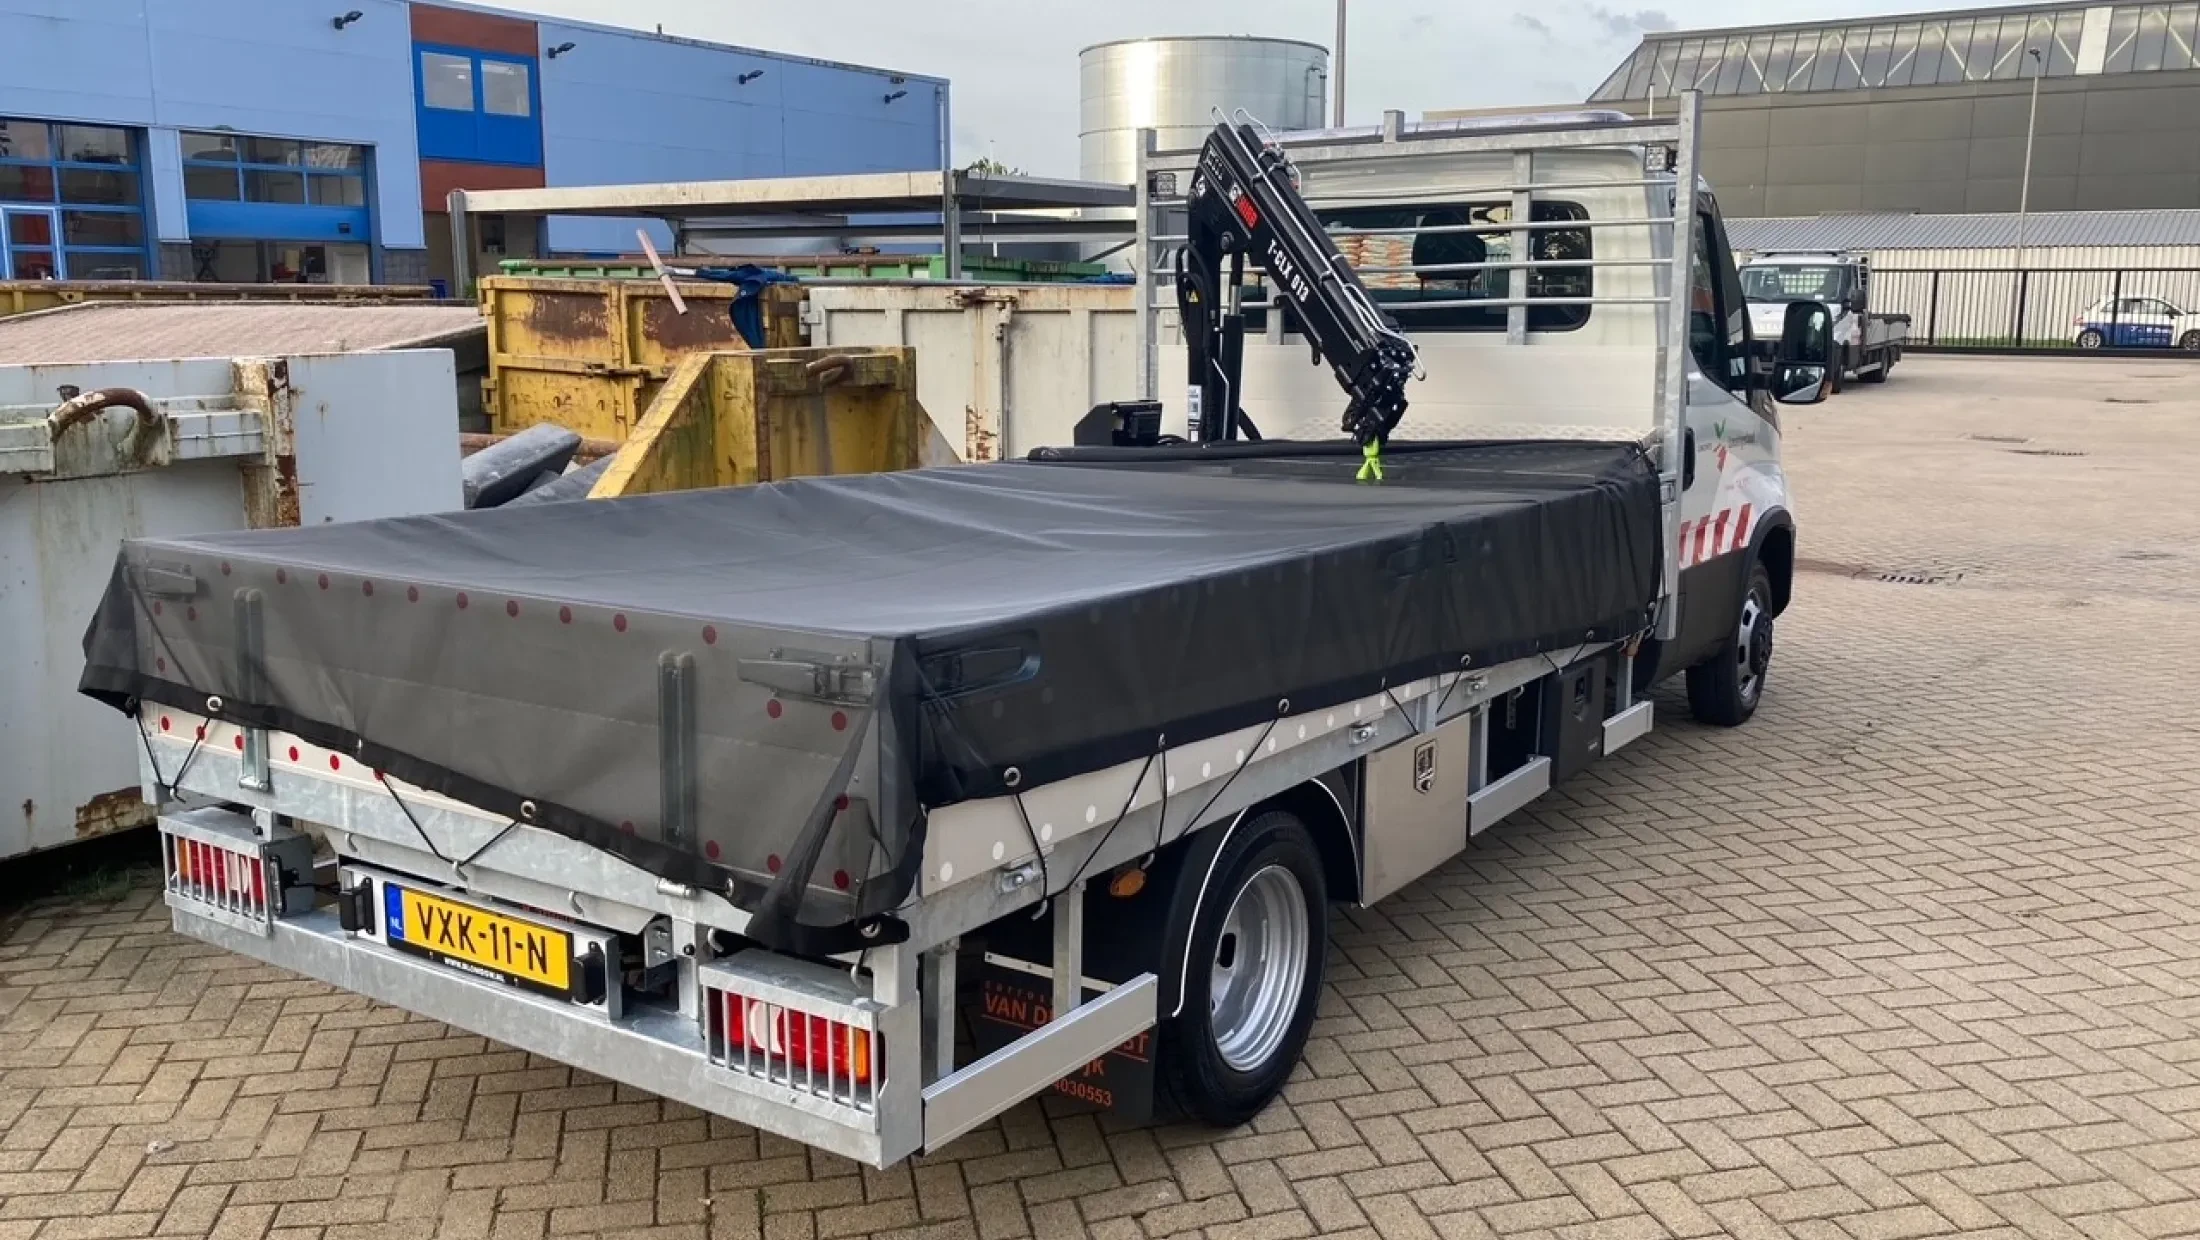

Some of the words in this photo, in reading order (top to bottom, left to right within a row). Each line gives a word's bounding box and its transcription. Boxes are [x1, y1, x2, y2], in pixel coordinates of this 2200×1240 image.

[1268, 238, 1293, 280] T-CLX
[390, 917, 403, 930] NL
[416, 902, 548, 974] VXK-11-N
[984, 992, 1027, 1022] VAN
